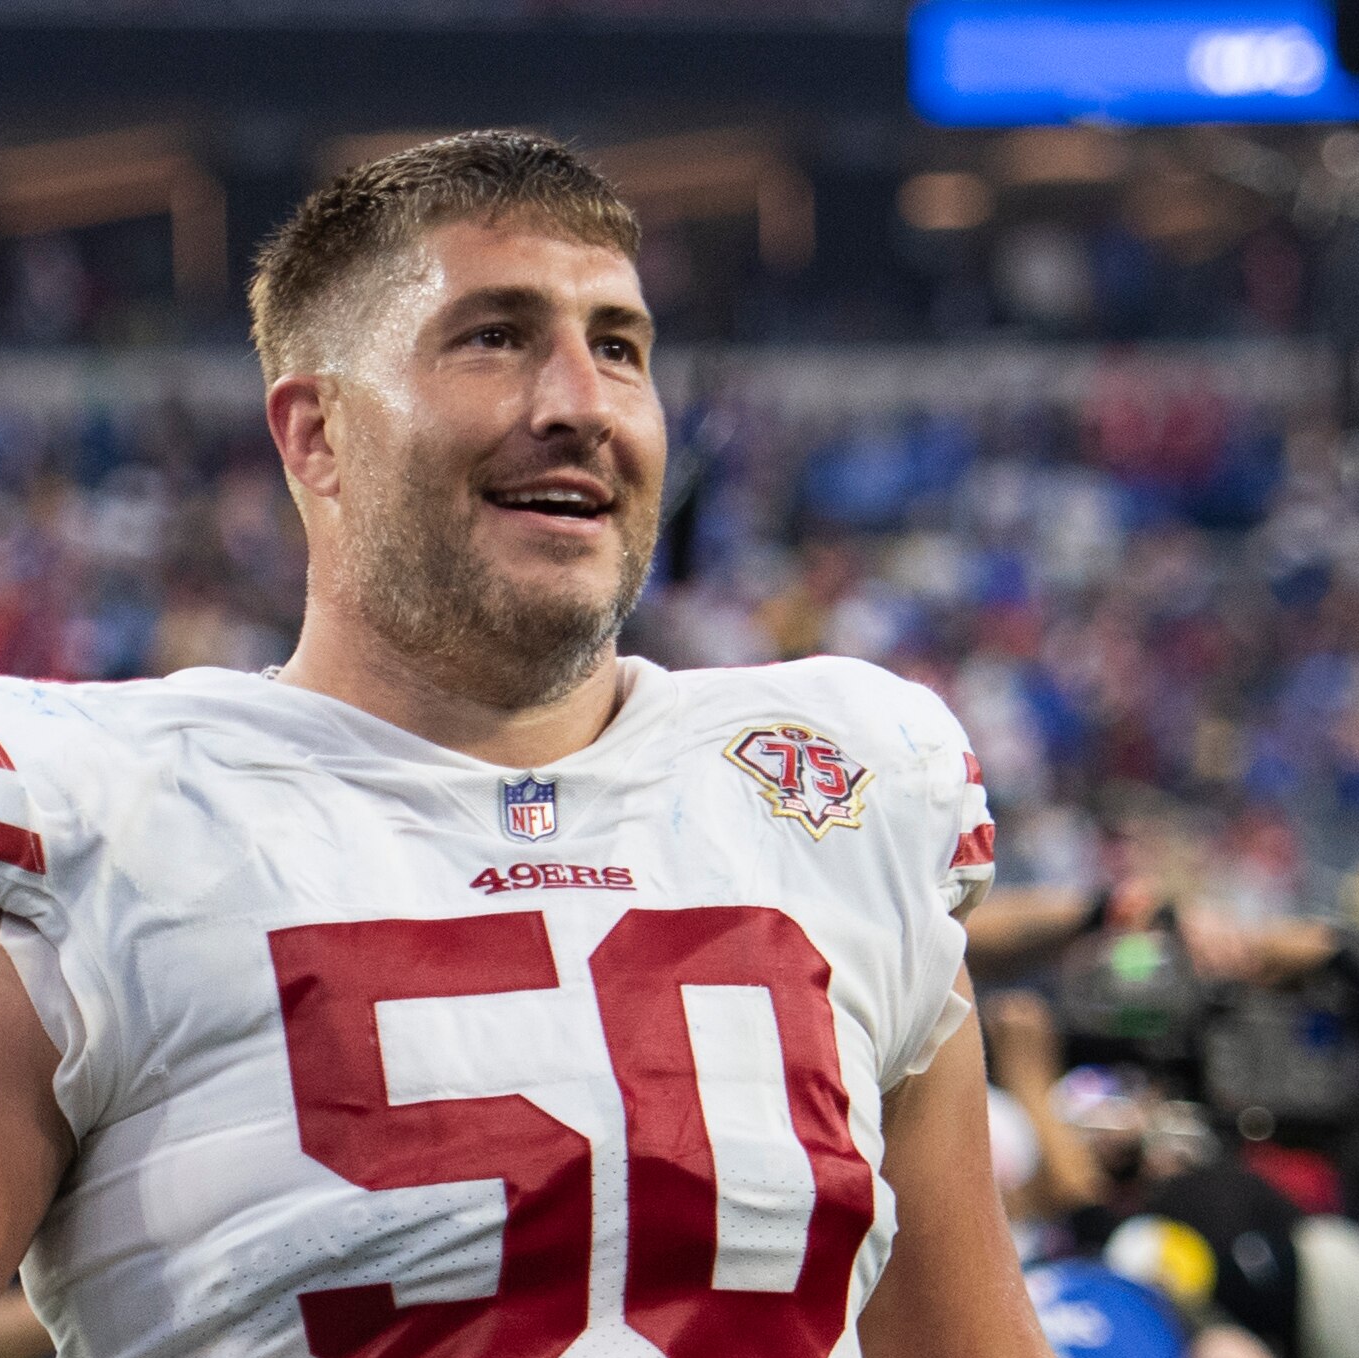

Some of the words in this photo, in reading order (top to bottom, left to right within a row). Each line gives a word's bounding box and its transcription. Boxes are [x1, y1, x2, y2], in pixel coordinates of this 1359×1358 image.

[759, 741, 850, 799] 75
[509, 805, 553, 836] NFL
[469, 863, 636, 895] 49ERS
